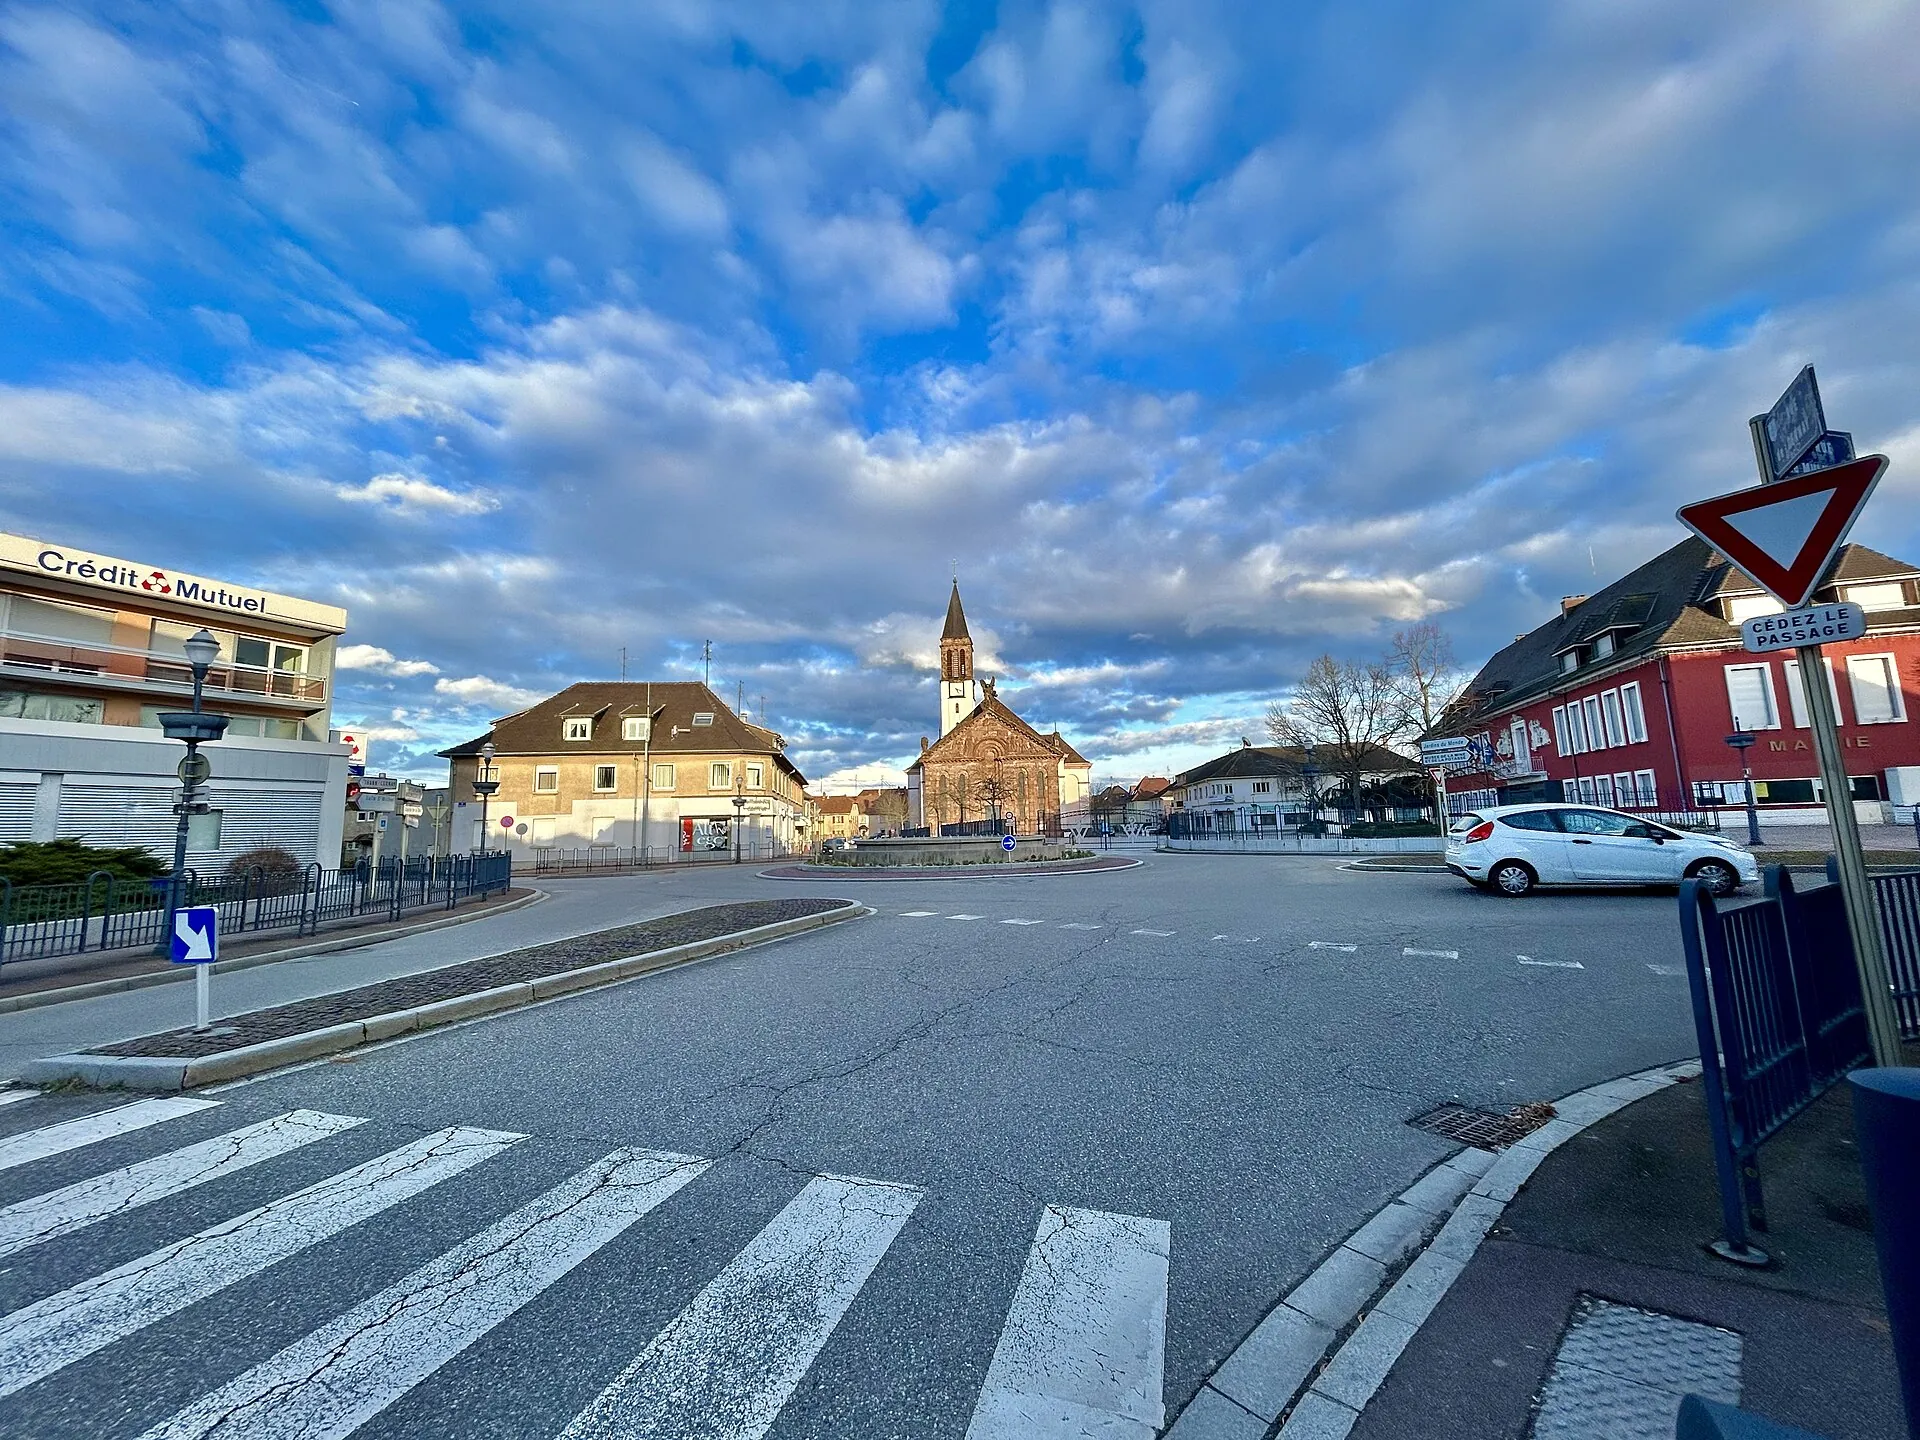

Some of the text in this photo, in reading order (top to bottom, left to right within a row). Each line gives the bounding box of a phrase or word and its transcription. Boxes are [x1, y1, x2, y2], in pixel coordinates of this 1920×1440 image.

[37, 550, 266, 613] Crédit Mutuel
[1752, 608, 1849, 633] CÉDEZ LE
[1757, 623, 1849, 646] PASSAGE
[1769, 735, 1871, 753] MAIE
